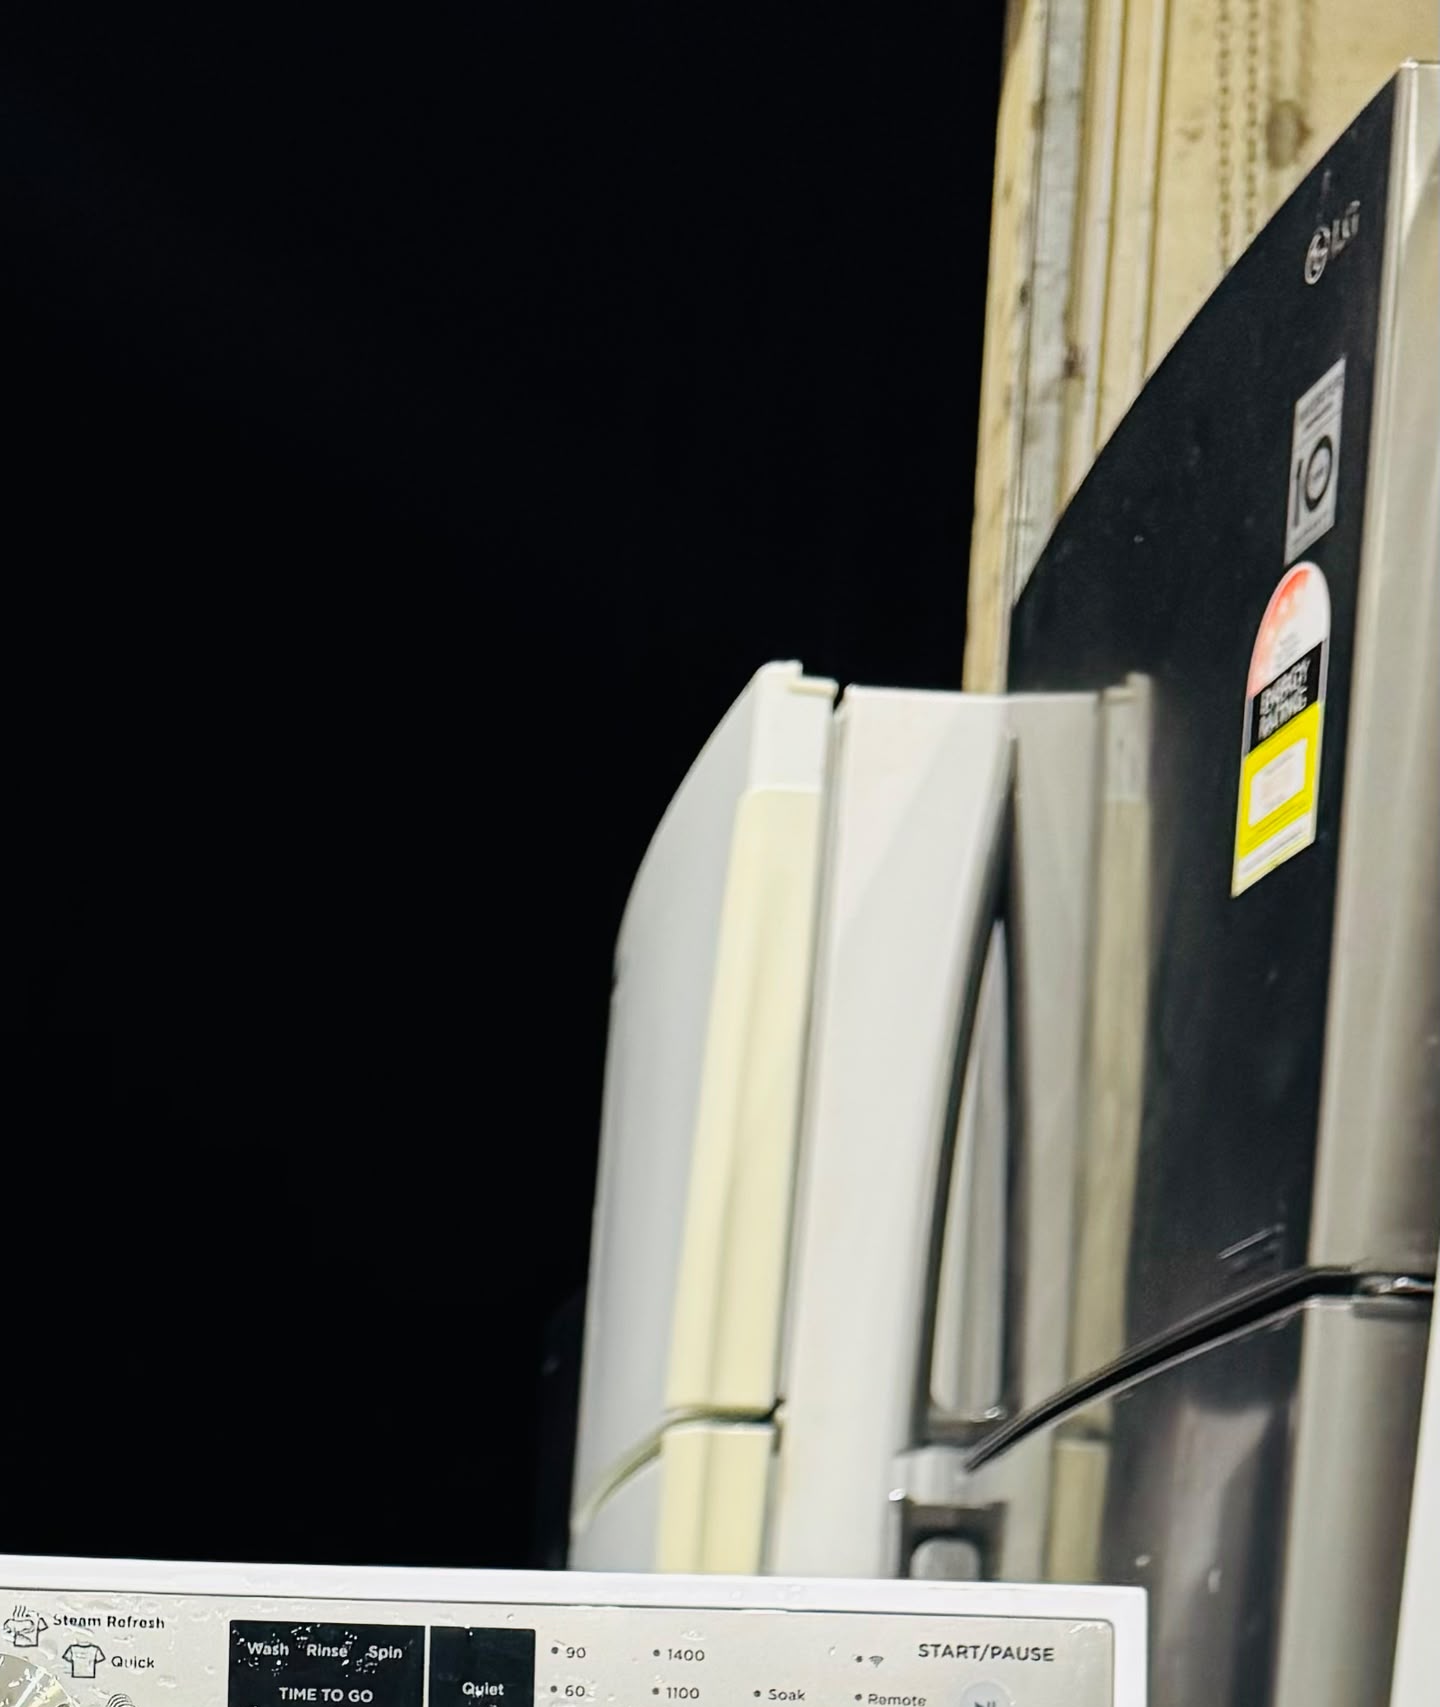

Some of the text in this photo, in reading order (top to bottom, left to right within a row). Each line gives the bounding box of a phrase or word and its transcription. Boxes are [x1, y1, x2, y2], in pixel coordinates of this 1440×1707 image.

[53, 1614, 103, 1629] Steam
[248, 1642, 403, 1661] Wash Rinse Spin
[565, 1646, 587, 1659] 90
[667, 1648, 705, 1662] 1400
[917, 1644, 1055, 1662] START/PAUSE
[111, 1655, 155, 1670] Quick
[279, 1687, 374, 1703] TIME TO GO
[461, 1682, 504, 1697] Quiet
[565, 1684, 585, 1698] 60
[666, 1686, 700, 1700] 1100
[768, 1689, 806, 1701] Soak
